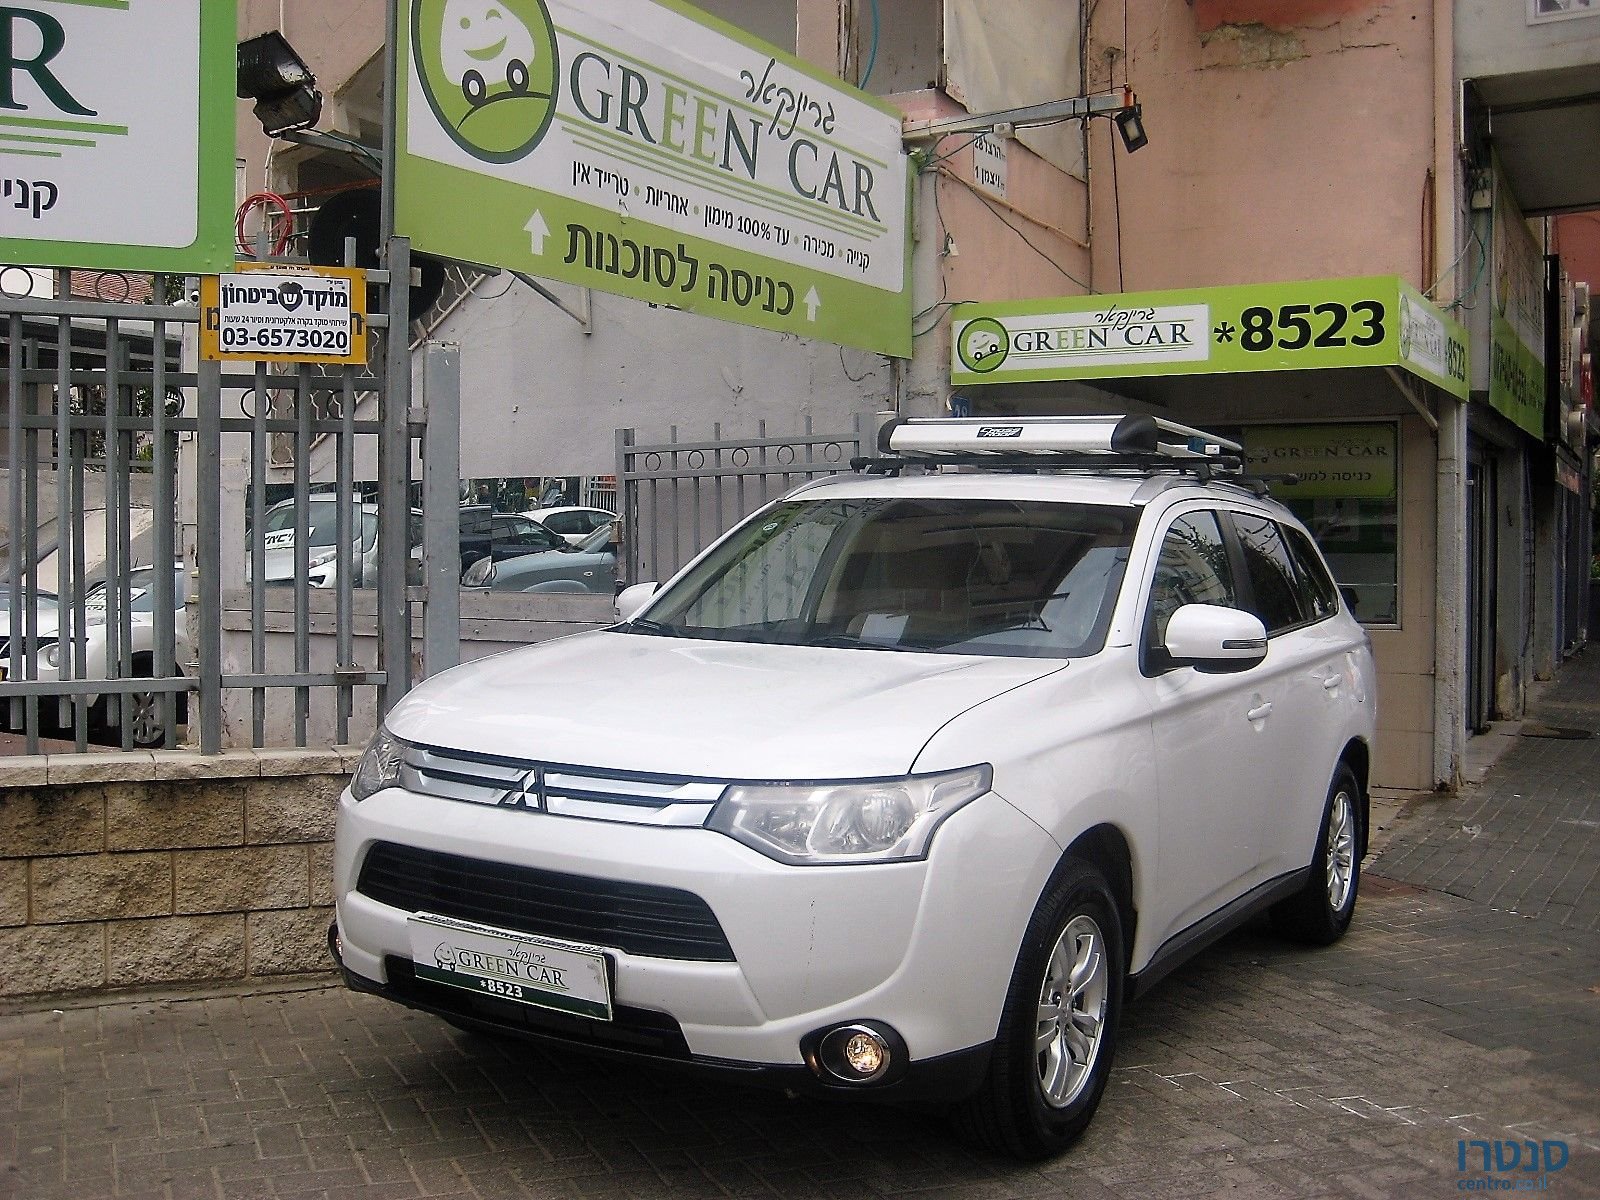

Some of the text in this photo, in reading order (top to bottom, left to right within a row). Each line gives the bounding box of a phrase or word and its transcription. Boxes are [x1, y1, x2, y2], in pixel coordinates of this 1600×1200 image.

[740, 57, 836, 141] גרינקאר
[570, 52, 881, 222] GREEN CAR
[974, 165, 979, 179] 1
[981, 168, 1000, 188] ויצמן
[0, 179, 58, 219] קני
[573, 160, 870, 273] קנייה מכירה עד 100% מימון אחריות טרייד אין
[564, 223, 795, 316] כניסה לסוכנות
[223, 315, 241, 323] שעות
[241, 315, 250, 324] 24
[265, 316, 296, 326] אלקטרונית
[296, 318, 314, 327] בקרה
[1094, 304, 1155, 331] גרינקאר
[222, 327, 348, 349] 03-6573020
[1013, 322, 1191, 352] GREEN CAR
[1273, 445, 1388, 458] GREEN CAR
[1296, 470, 1372, 482] כניסה למש
[458, 951, 566, 987] GREEN CAR
